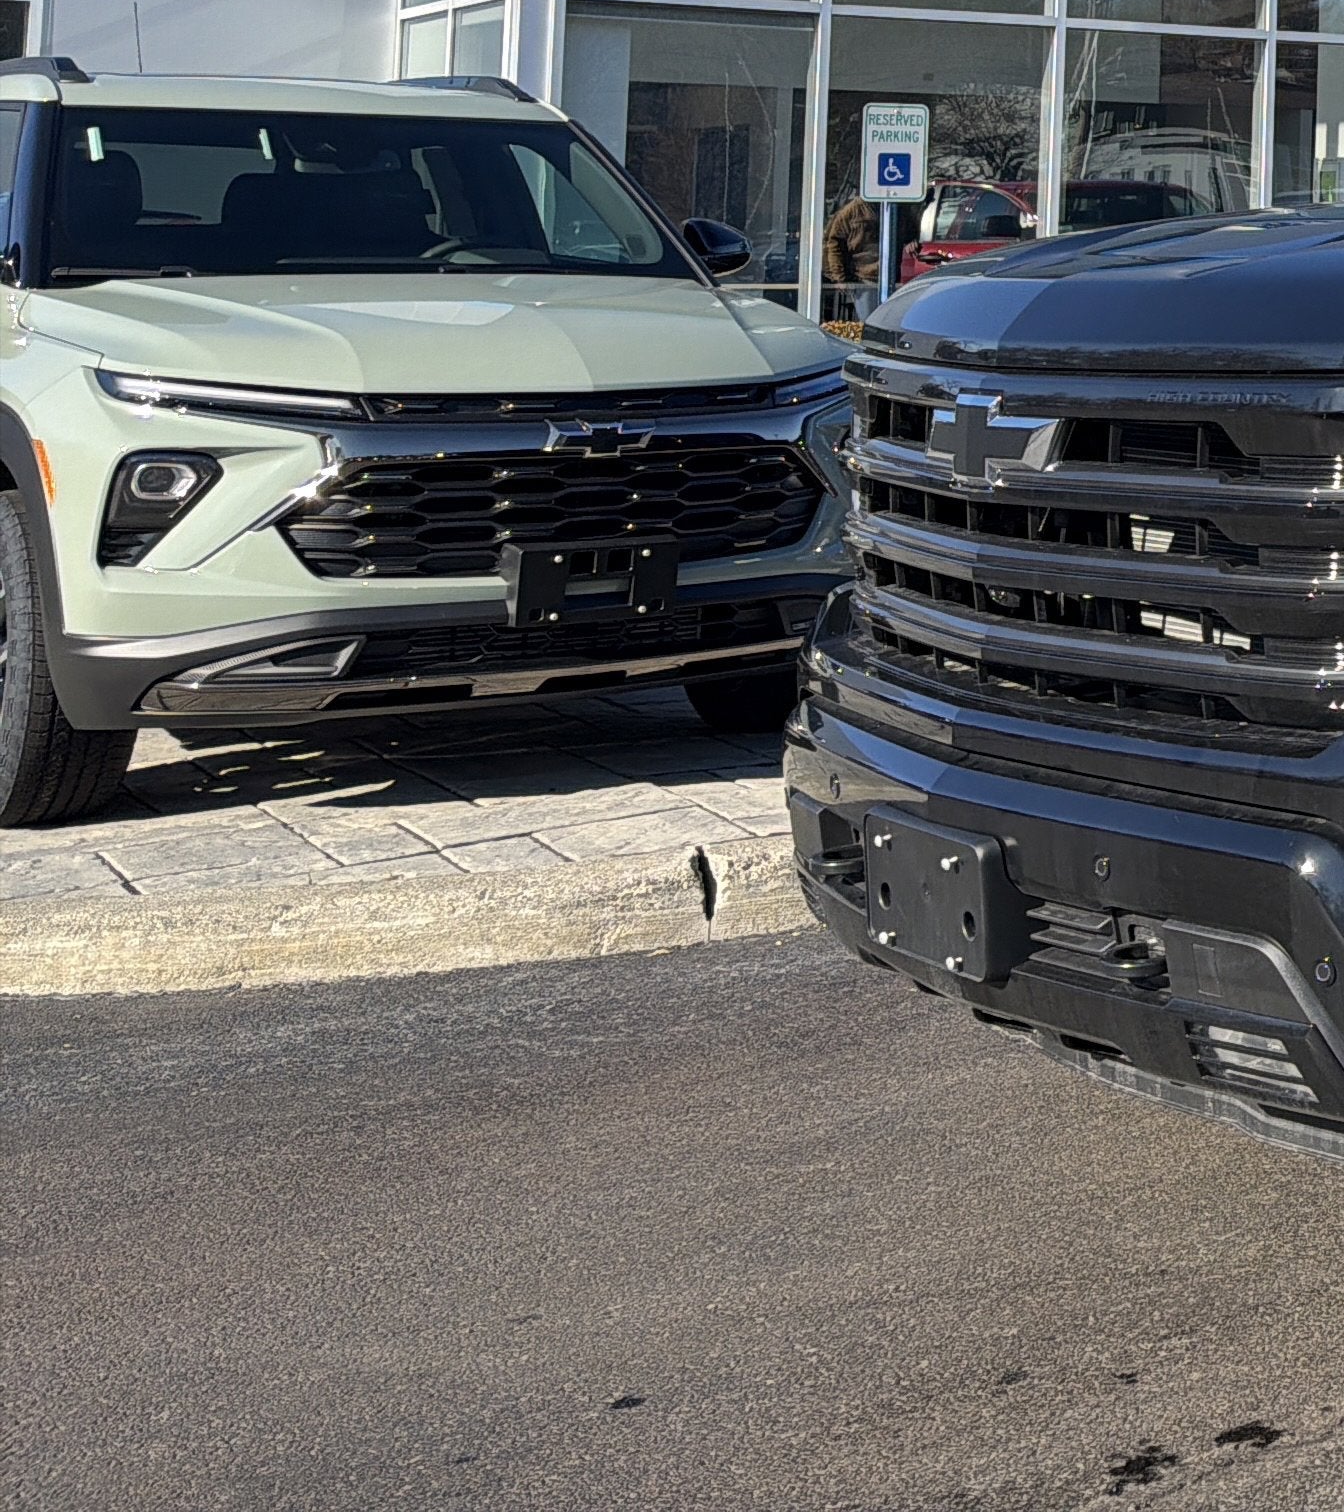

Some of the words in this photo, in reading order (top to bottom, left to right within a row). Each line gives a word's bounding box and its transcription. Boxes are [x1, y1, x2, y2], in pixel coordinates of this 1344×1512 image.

[868, 113, 924, 127] RESERVED
[871, 129, 920, 143] PARKING
[1147, 390, 1192, 403] HIGH
[1197, 391, 1292, 405] COUNTRY
